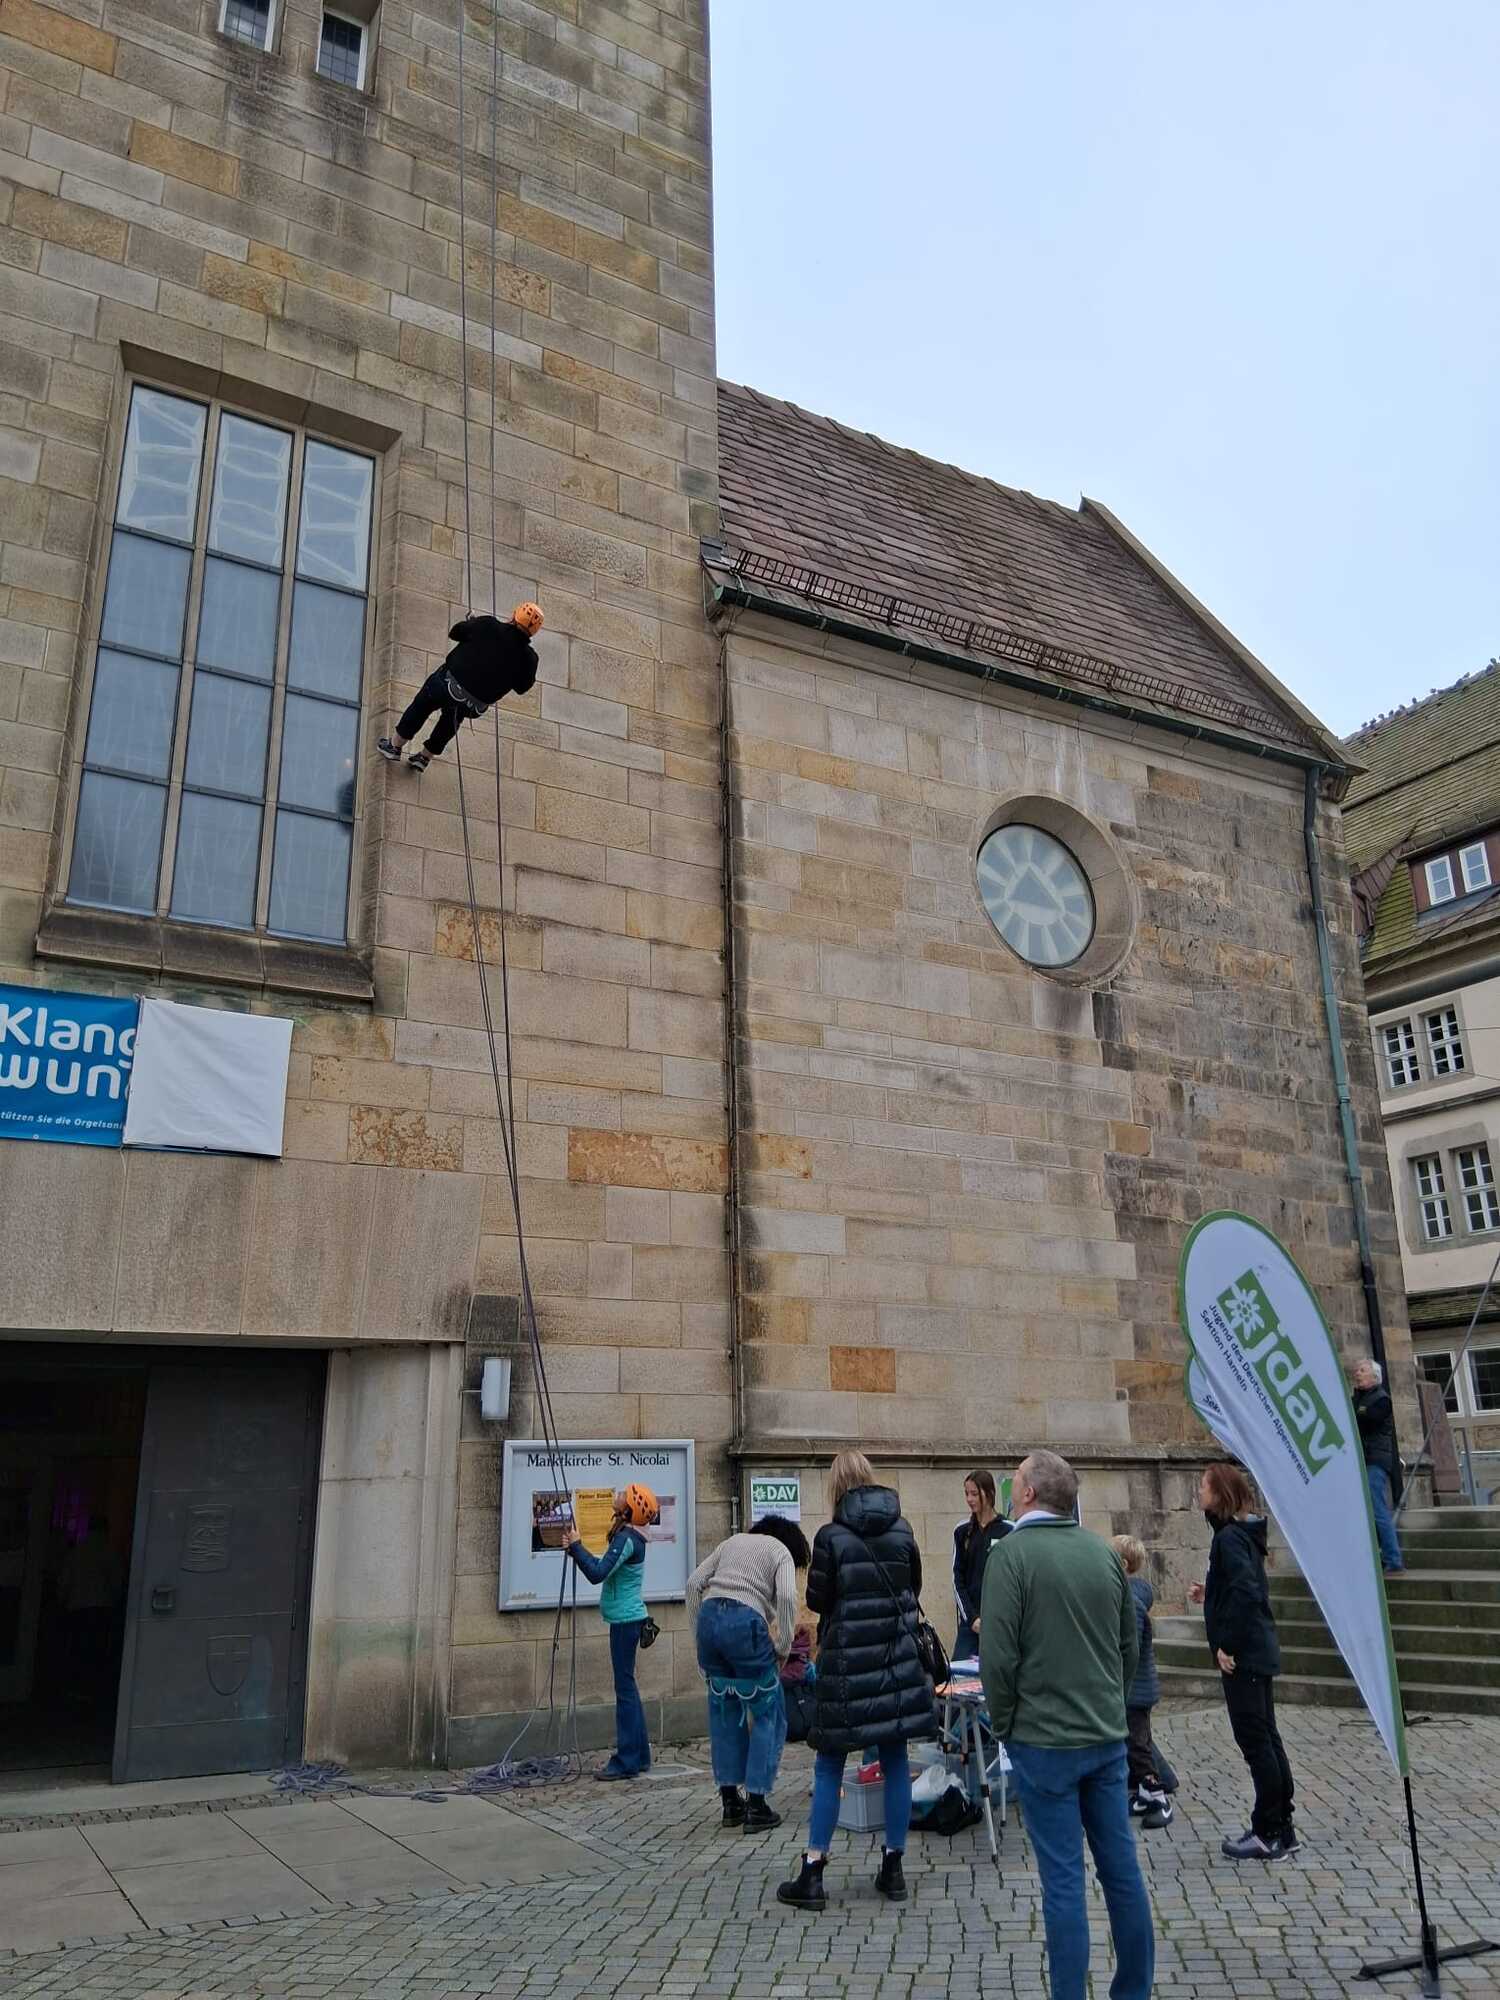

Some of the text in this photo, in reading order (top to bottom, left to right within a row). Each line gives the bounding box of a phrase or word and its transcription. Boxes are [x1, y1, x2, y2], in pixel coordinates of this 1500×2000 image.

[0, 1053, 131, 1100] wun
[36, 1115, 53, 1124] Sie
[55, 1116, 72, 1125] die
[1200, 1309, 1249, 1392] Sektion Hameln
[1208, 1304, 1310, 1486] Jugend des Deutschen Alpenvereins
[527, 1452, 670, 1467] Marktkirche St. Nicolai
[767, 1485, 796, 1500] DAV
